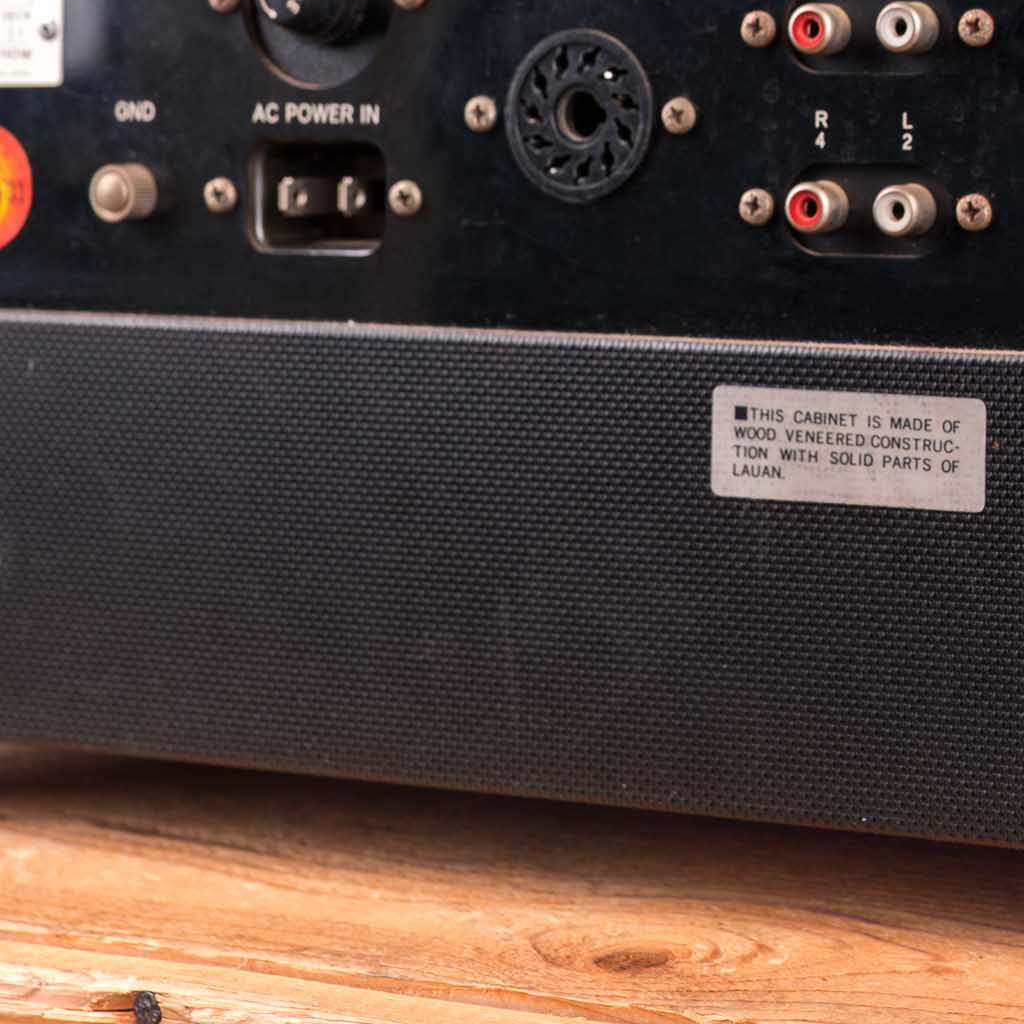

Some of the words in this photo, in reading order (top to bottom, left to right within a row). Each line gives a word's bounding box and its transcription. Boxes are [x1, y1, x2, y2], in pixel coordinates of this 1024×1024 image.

[114, 100, 156, 122] GND
[251, 103, 279, 124] AC
[285, 103, 354, 125] POWER
[360, 103, 381, 125] IN
[813, 110, 829, 129] R
[902, 112, 912, 129] L
[814, 131, 826, 149] 4
[901, 133, 912, 150] 2
[750, 407, 784, 423] THIS
[793, 409, 857, 427] CABINET
[867, 415, 881, 429] IS
[889, 417, 933, 433] MADE
[942, 419, 960, 434] OF
[734, 426, 776, 441] WOOD
[785, 428, 865, 447] VENEERED
[870, 433, 960, 454] CONSTRUC-
[733, 444, 768, 460] TION
[779, 447, 818, 463] WITH
[830, 451, 873, 467] SOLID
[882, 455, 932, 472] PARTS
[941, 459, 960, 473] OF
[732, 463, 785, 479] LAUAN.
